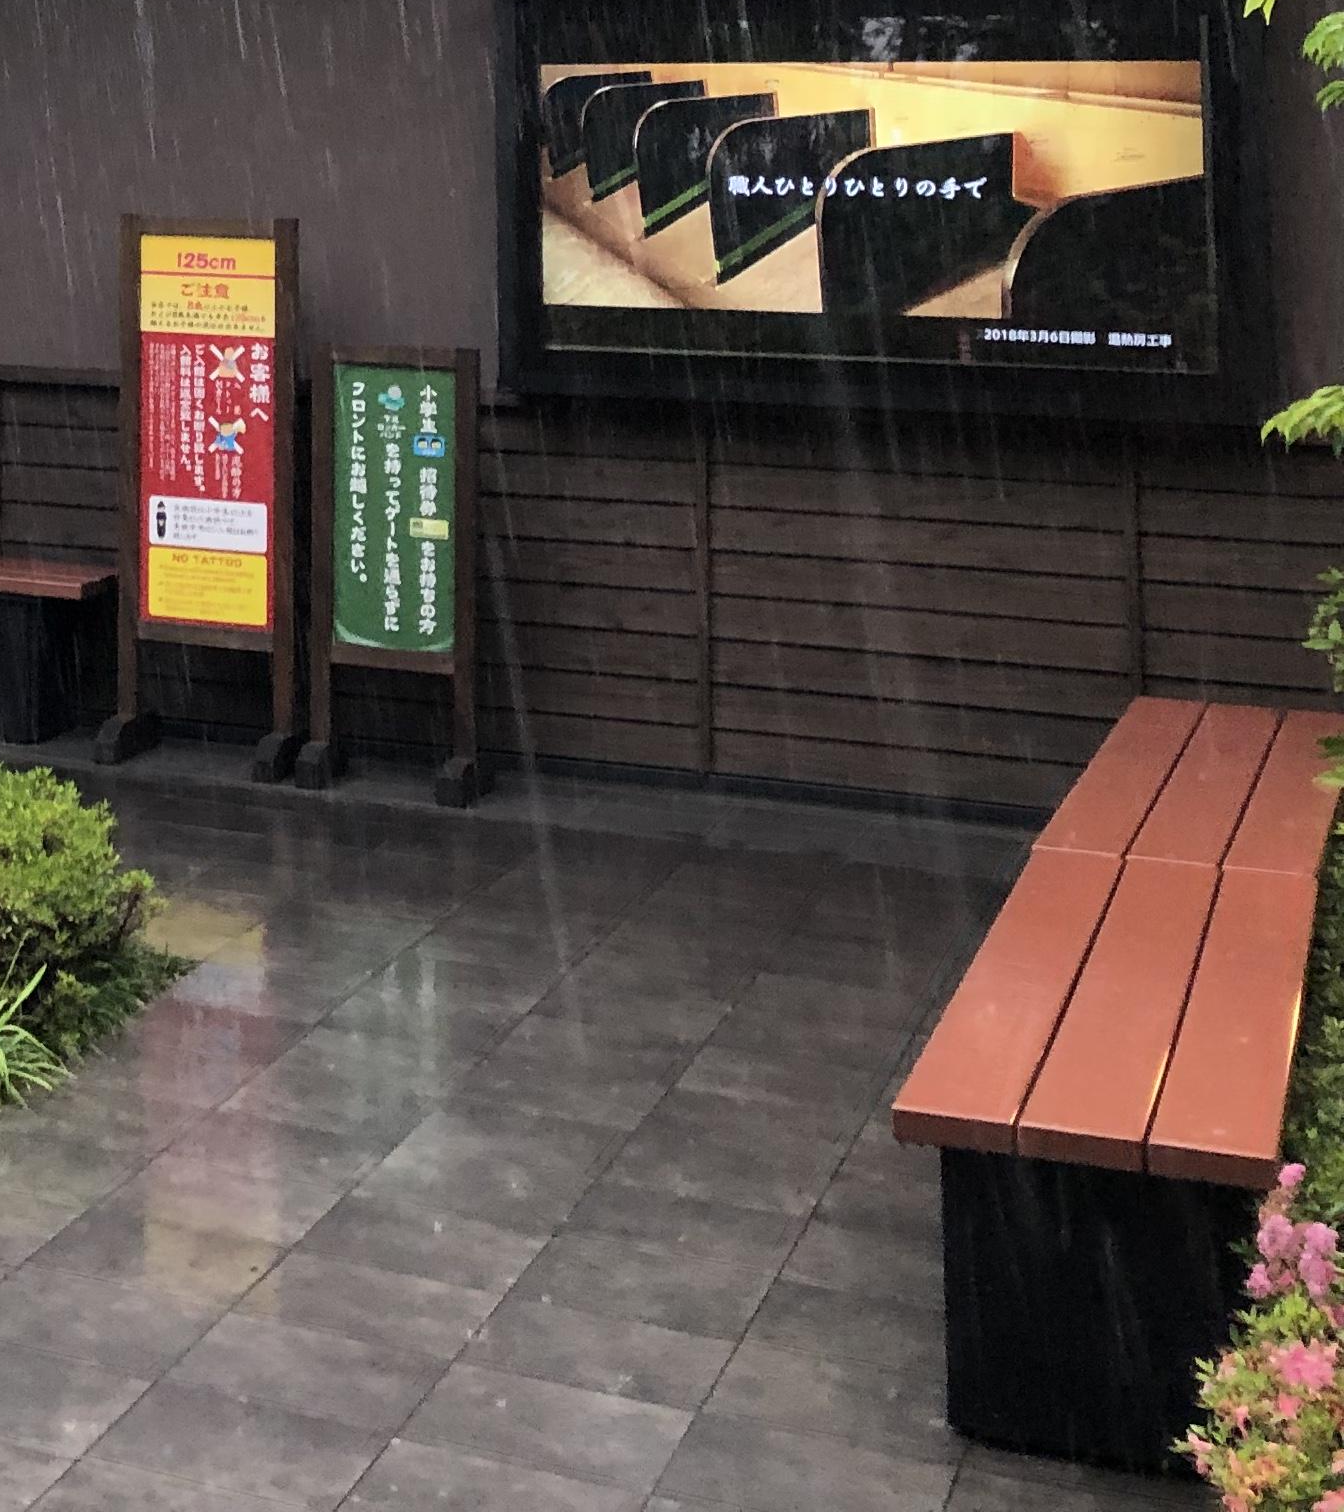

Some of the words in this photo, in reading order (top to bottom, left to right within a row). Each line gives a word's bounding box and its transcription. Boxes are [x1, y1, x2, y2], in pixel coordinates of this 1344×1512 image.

[728, 175, 988, 200] 職人ひとりひとりの手で
[176, 251, 237, 271] 125cm
[180, 282, 230, 300] ご注意
[249, 342, 272, 423] お客様へ
[419, 384, 439, 434] 小学生
[349, 381, 368, 583] フロントにお越しください。
